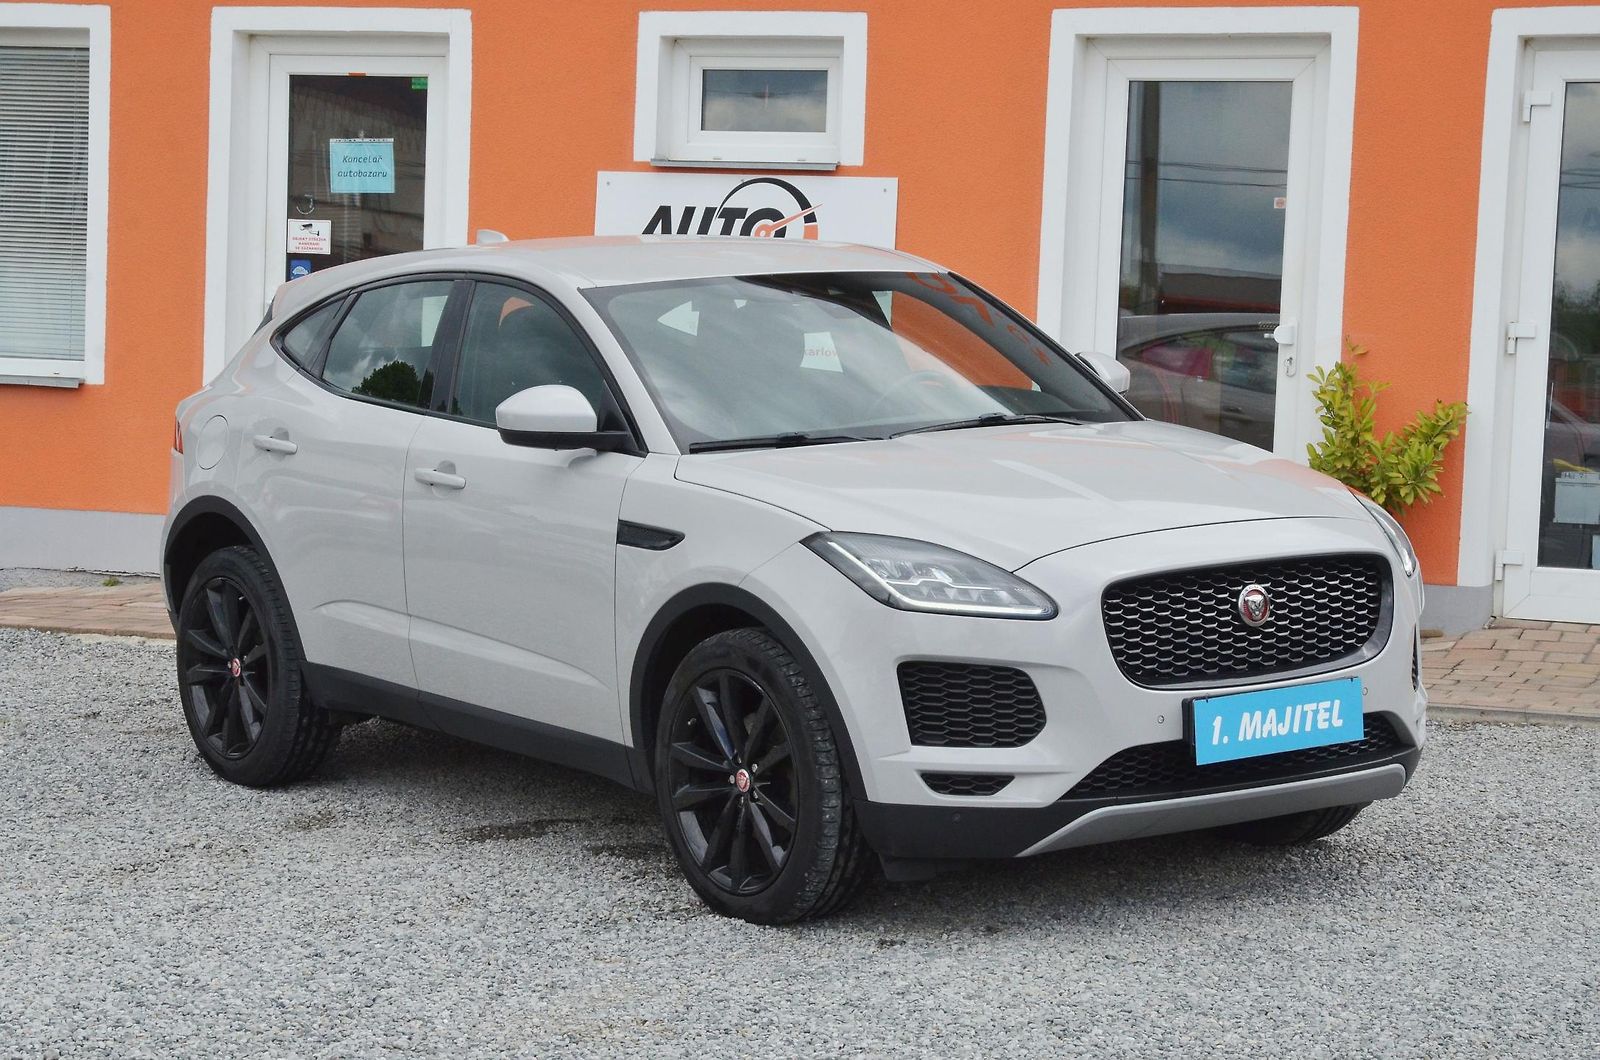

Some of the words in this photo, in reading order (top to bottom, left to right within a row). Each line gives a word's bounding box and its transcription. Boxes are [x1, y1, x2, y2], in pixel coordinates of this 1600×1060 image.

[337, 169, 388, 178] autobazaru
[641, 204, 788, 239] AUTO
[1212, 715, 1229, 745] 1.
[1238, 699, 1343, 742] MAJITEL
